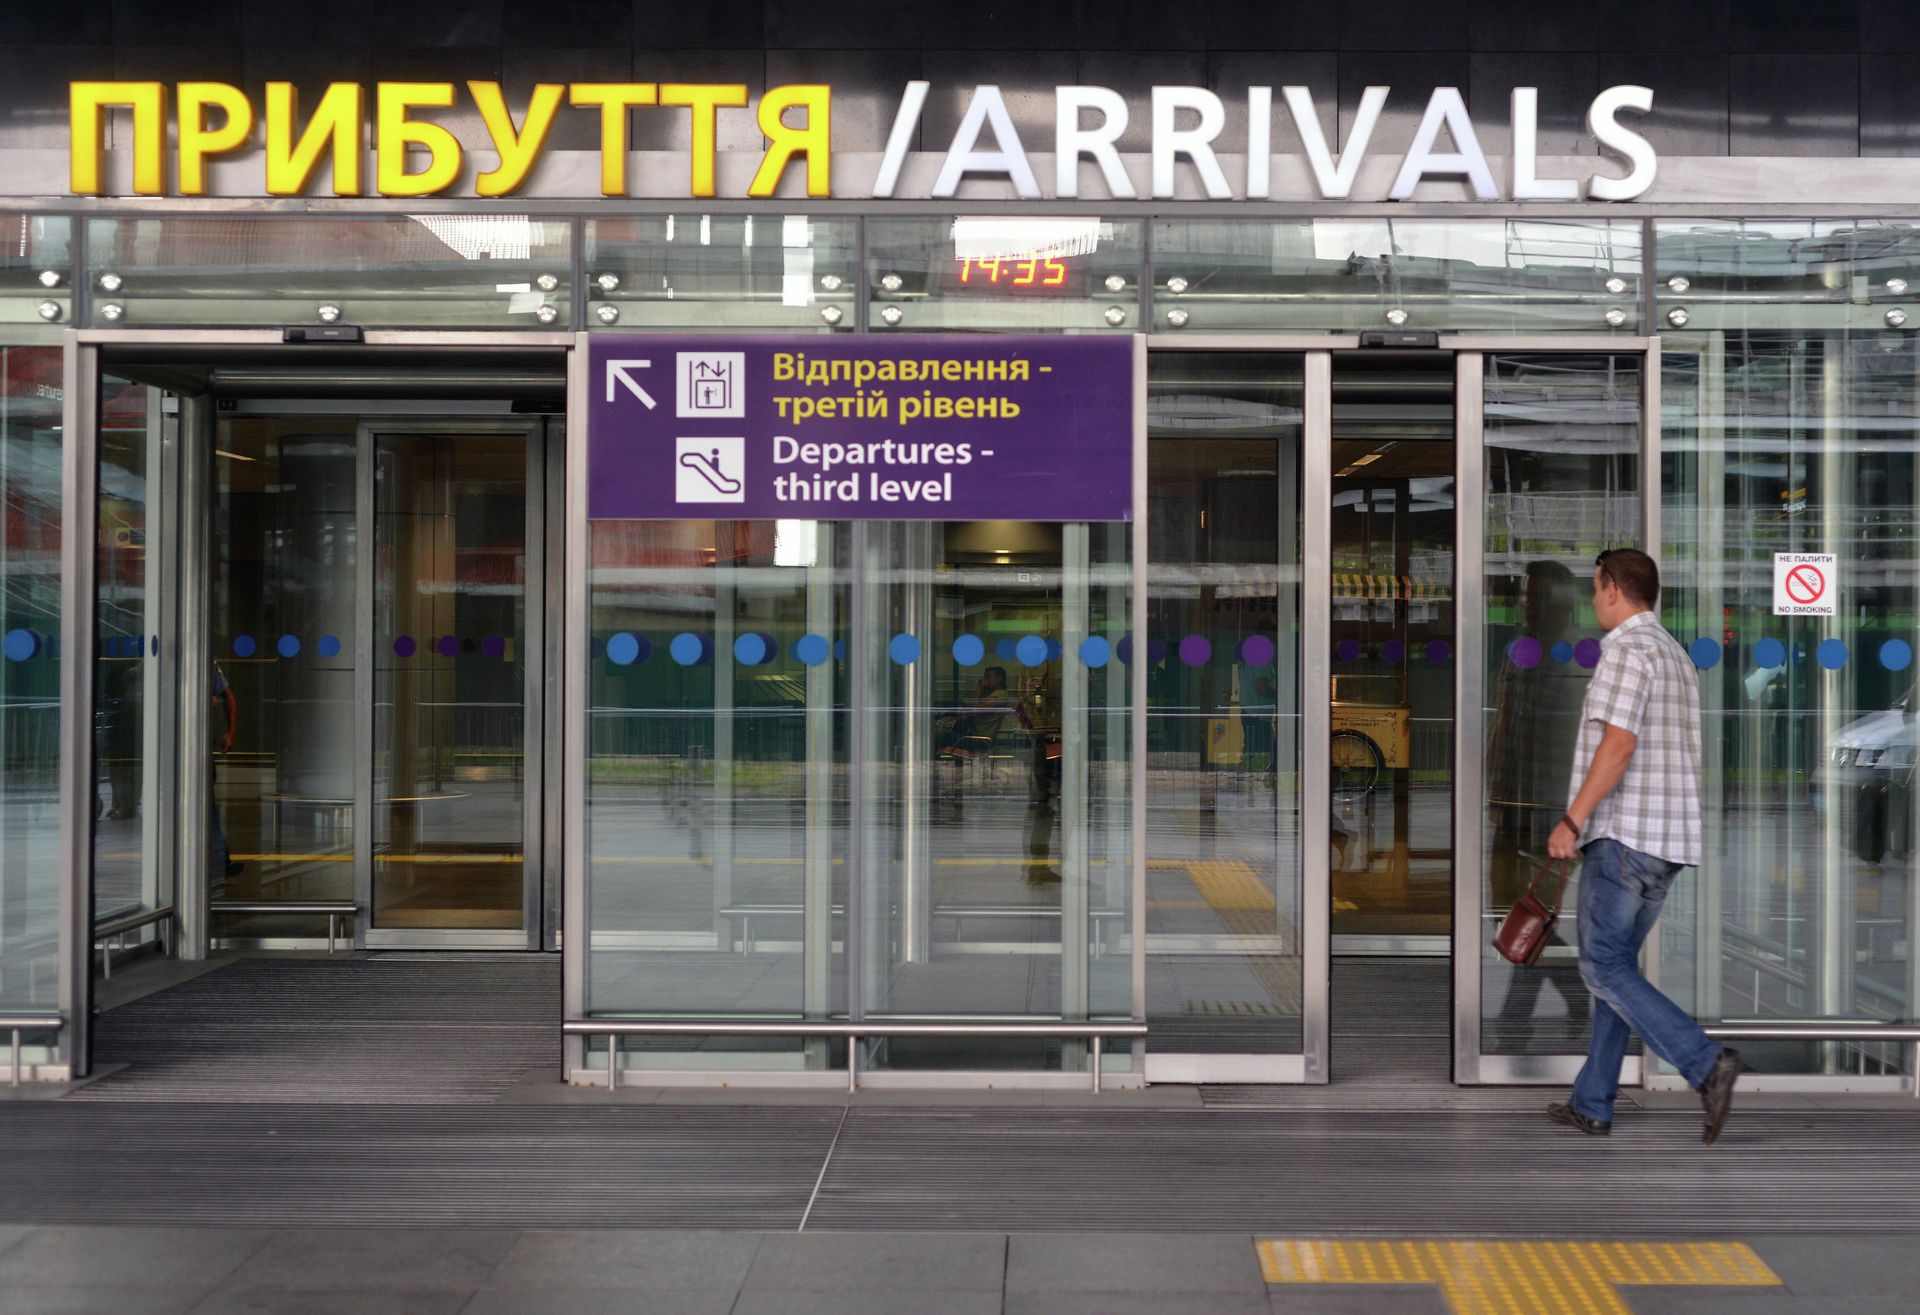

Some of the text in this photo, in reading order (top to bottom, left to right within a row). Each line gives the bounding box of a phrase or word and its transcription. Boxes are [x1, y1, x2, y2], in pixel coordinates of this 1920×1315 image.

[69, 80, 832, 198] ПРИБУТТЯ
[773, 353, 1030, 388] Відправлення
[773, 389, 1021, 425] третій рівень
[773, 435, 973, 471] Departures
[773, 472, 952, 501] third level
[1779, 555, 1833, 563] НЕ ПАЛИТИ
[1793, 606, 1833, 614] SMOKING
